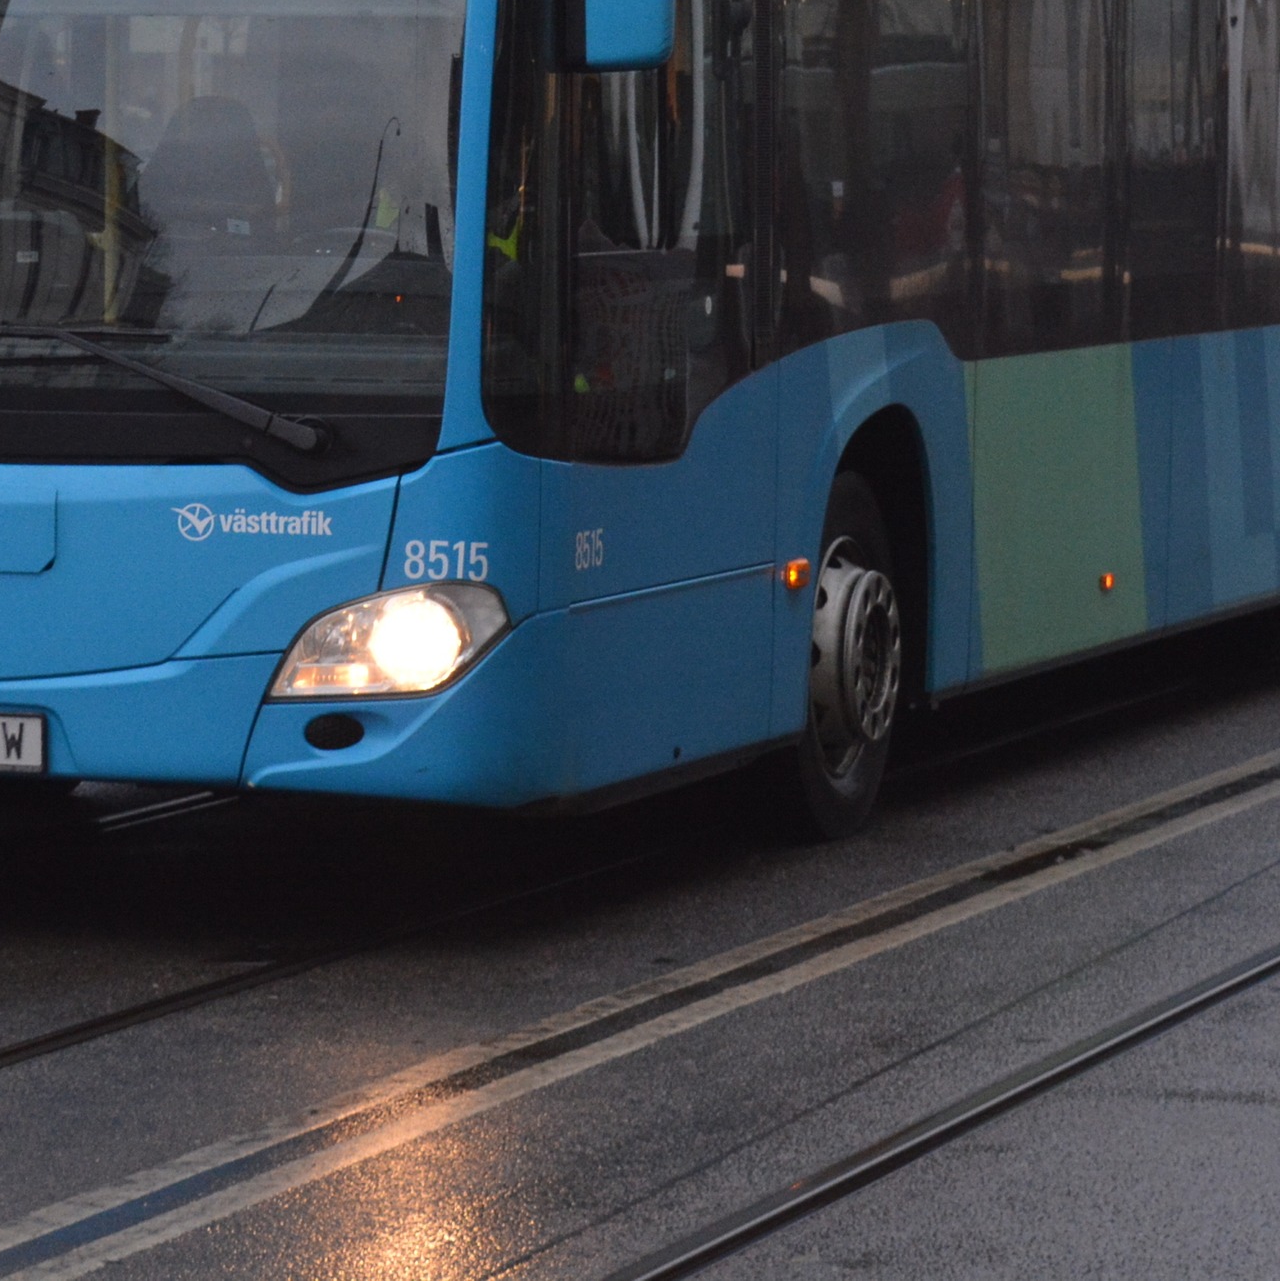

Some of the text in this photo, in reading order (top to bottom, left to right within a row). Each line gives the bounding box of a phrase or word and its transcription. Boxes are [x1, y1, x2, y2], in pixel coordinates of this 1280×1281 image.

[219, 507, 333, 536] västtrafik
[403, 540, 490, 582] 8515
[575, 528, 604, 571] 8515
